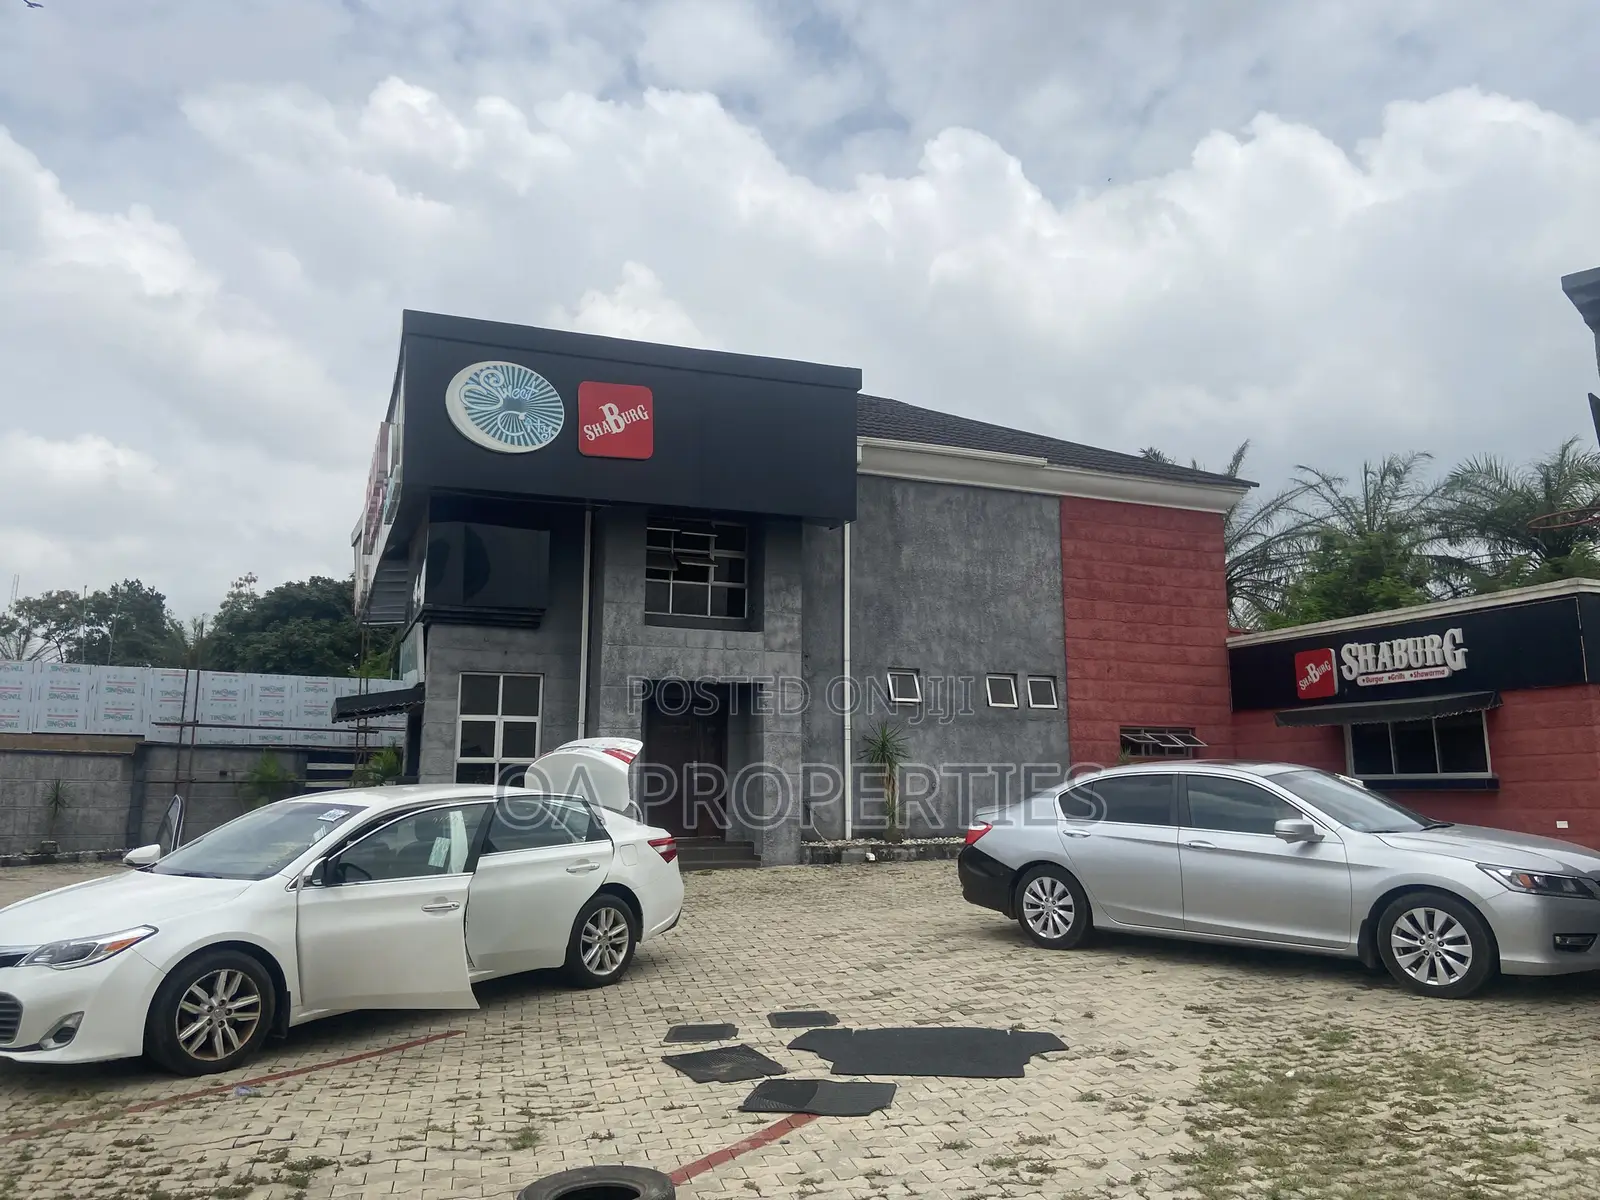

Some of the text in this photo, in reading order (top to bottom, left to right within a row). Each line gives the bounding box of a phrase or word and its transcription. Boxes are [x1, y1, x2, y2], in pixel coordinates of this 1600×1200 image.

[459, 368, 540, 411] Sweet
[497, 410, 556, 441] City
[1340, 628, 1468, 681] SHABURG
[1366, 676, 1384, 684] Burger
[1413, 669, 1446, 678] Shawarma
